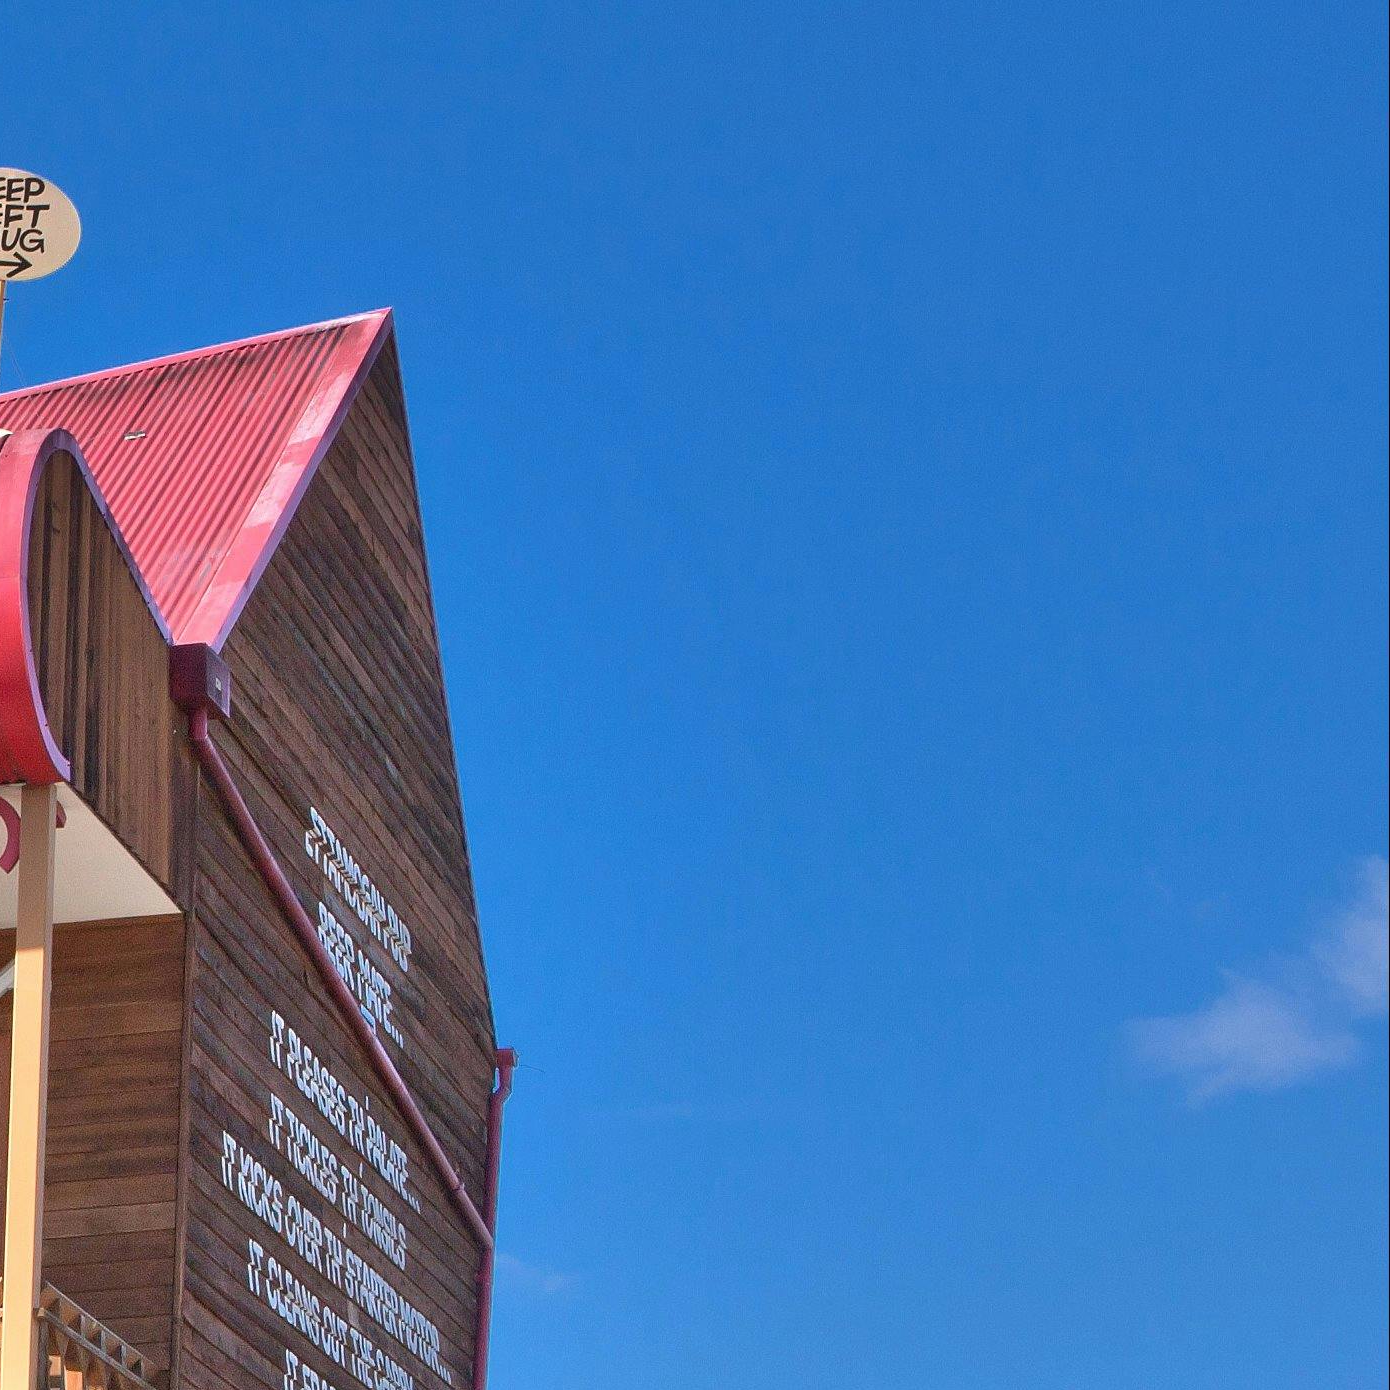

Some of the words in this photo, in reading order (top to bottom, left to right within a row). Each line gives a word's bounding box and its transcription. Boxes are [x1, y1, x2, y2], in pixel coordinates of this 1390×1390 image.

[383, 903, 412, 973] PUB
[270, 1010, 284, 1069] IT
[287, 1027, 347, 1136] PLEASES
[269, 1093, 284, 1150] IT
[285, 1107, 338, 1205] TICKLES
[221, 1130, 236, 1191] IT
[238, 1146, 283, 1234] KICKS
[285, 1195, 323, 1273] OVER
[345, 1248, 398, 1340] STARTER
[248, 1238, 263, 1296] IT
[266, 1256, 320, 1347] CLEANS
[321, 1305, 348, 1368] OUT
[349, 1326, 374, 1389] THE
